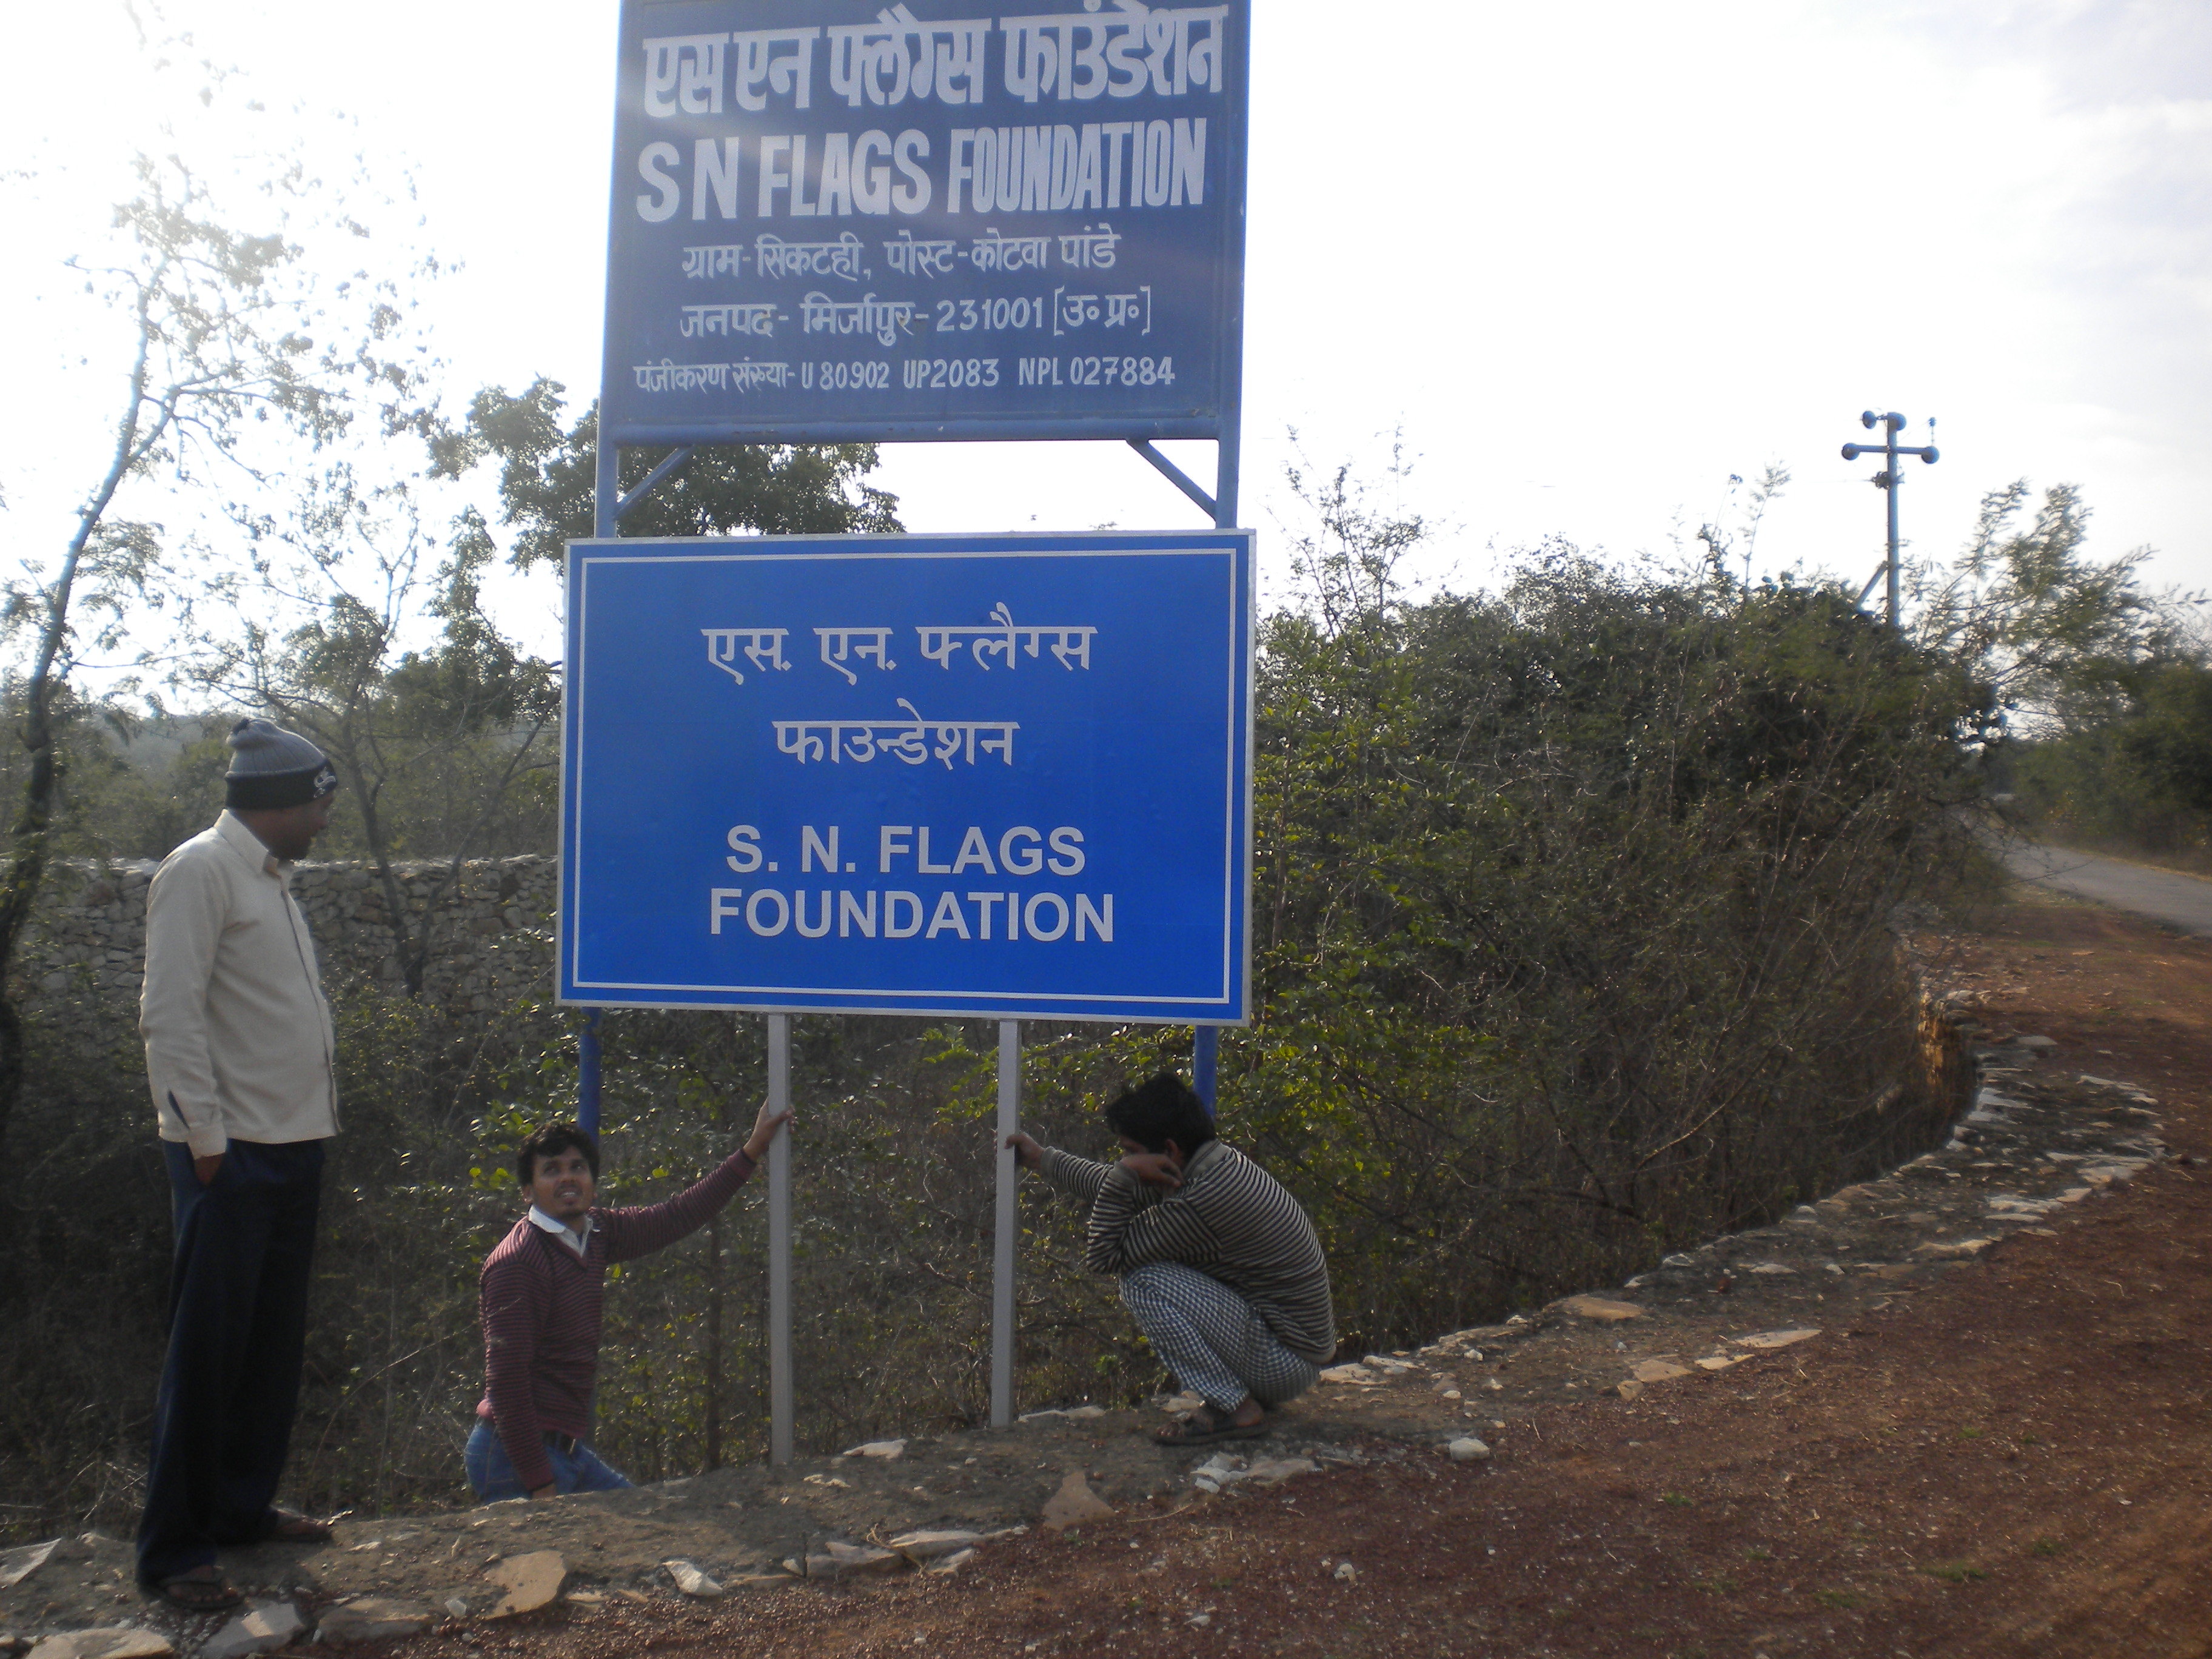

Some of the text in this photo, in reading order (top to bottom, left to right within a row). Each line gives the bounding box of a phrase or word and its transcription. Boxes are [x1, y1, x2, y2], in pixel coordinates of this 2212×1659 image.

[643, 33, 729, 118] एस
[732, 27, 821, 111] एन
[999, 0, 1230, 103] फाउंडेशन
[636, 117, 1208, 223] S N FLAGS FOUNDATION
[632, 358, 730, 397] पंजीकरण
[819, 361, 890, 391] 80902
[903, 358, 999, 389] UP2083
[1019, 357, 1064, 386] NPL
[1070, 356, 1176, 386] 027884
[700, 601, 1099, 686] एस. एन. फ्लैग्स
[771, 697, 1021, 771] फाउन्डेशन
[726, 824, 1086, 876] S. N. FLAGS
[710, 887, 1114, 943] FOUNDATION
